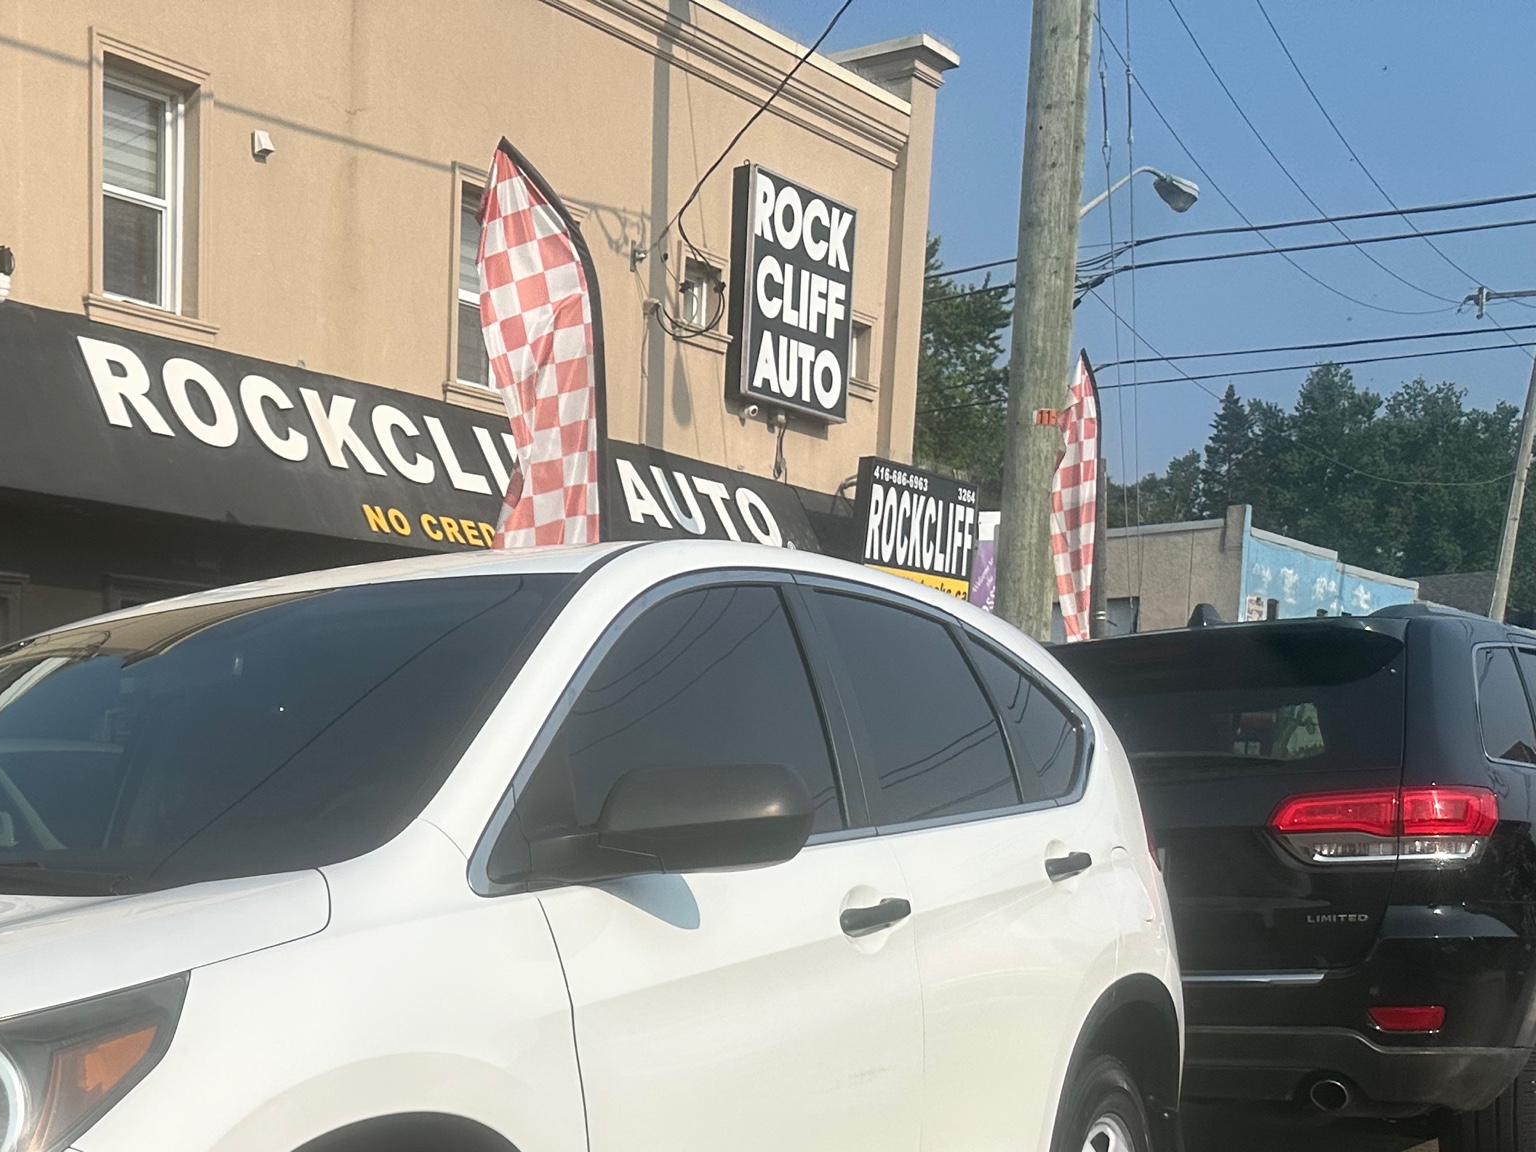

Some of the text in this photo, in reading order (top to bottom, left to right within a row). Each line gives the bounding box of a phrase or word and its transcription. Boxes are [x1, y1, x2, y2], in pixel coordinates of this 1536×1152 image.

[754, 171, 853, 273] ROCK
[756, 255, 846, 340] CLIFF
[752, 329, 842, 410] AUTO
[77, 335, 783, 548] ROCKCLI AUTO
[873, 465, 929, 492] 416-686-6963
[362, 503, 496, 549] NO CRED
[865, 483, 975, 577] ROCKCLIFF
[957, 487, 976, 504] 3264
[1307, 914, 1369, 923] LIMITED
